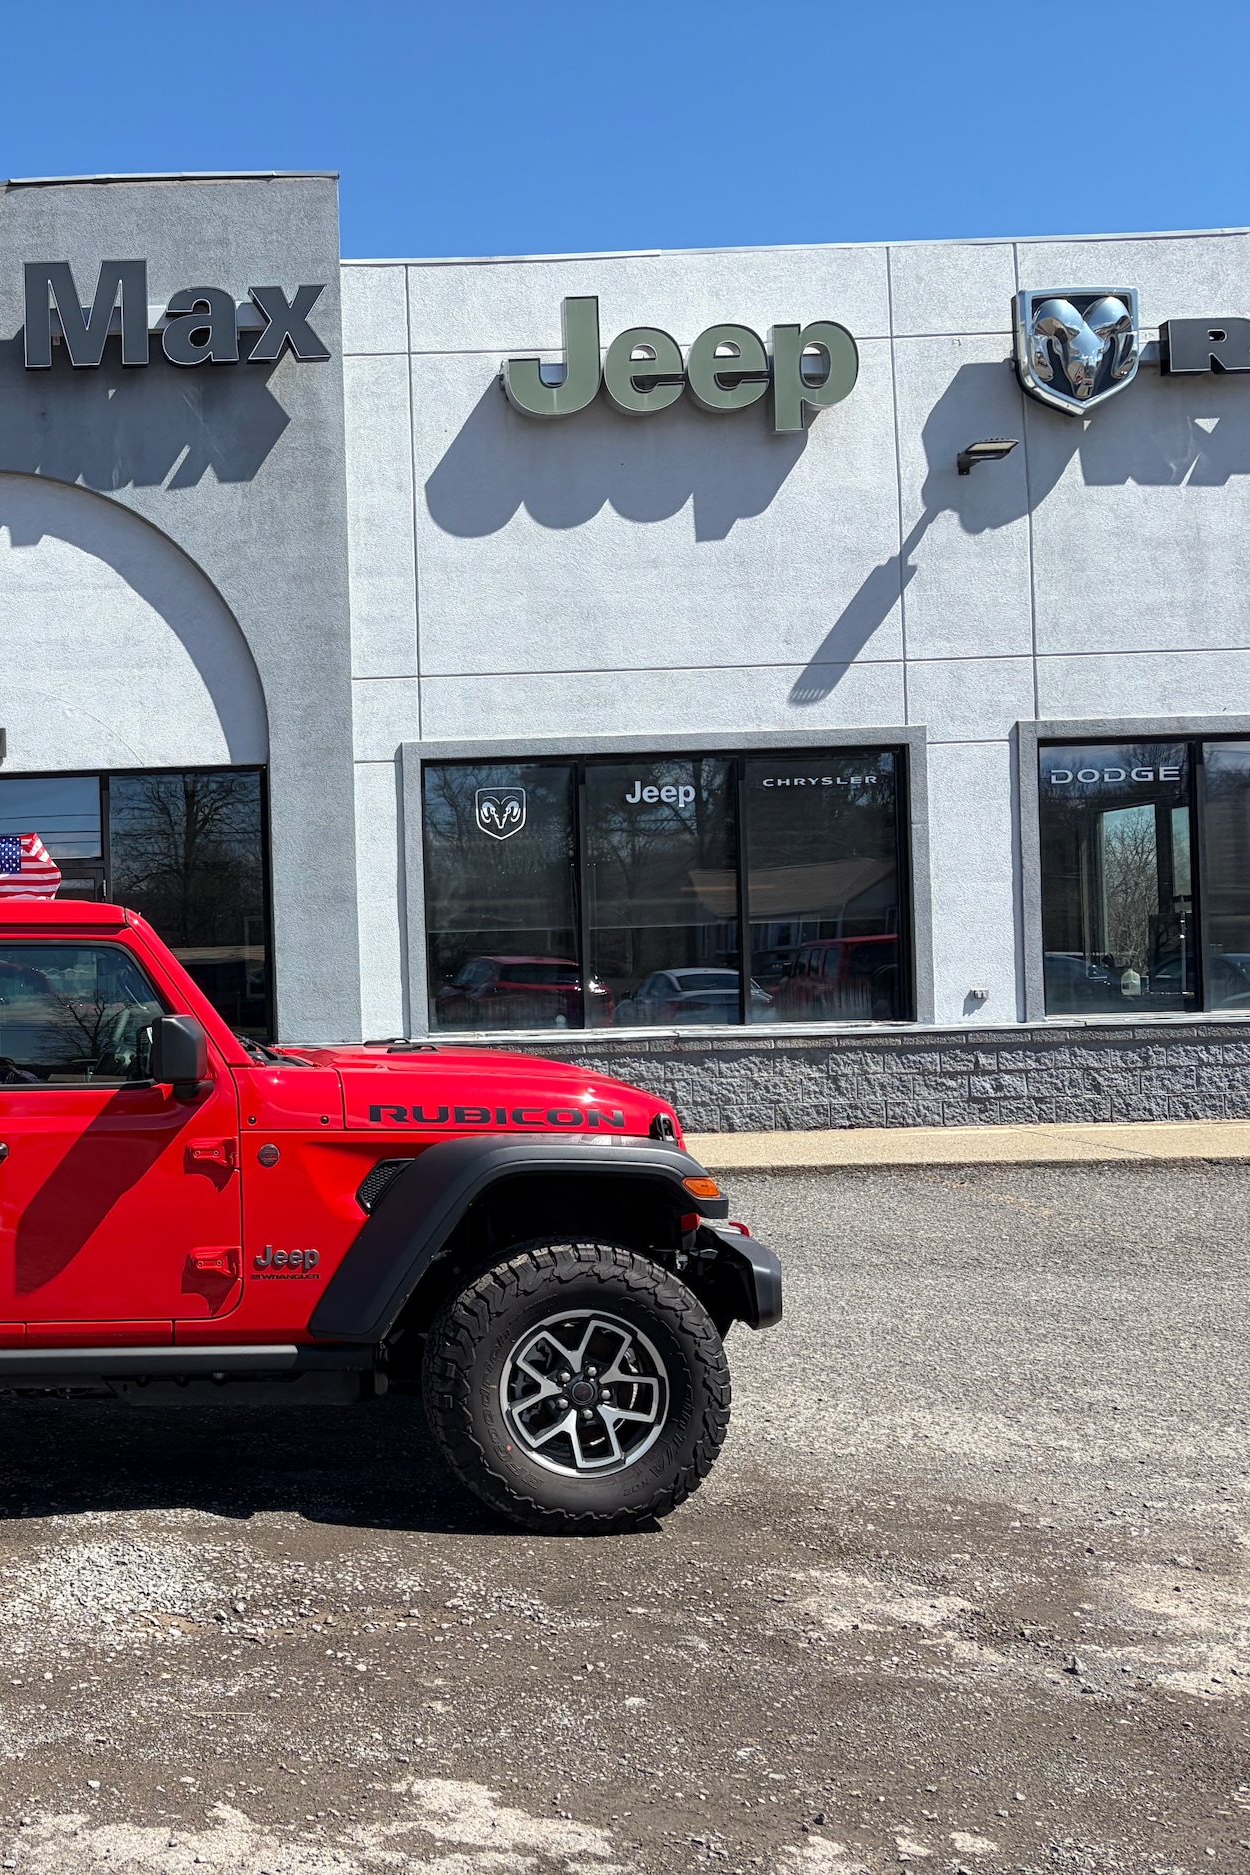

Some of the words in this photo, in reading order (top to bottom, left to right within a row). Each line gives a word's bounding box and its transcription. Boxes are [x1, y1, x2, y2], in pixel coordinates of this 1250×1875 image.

[23, 259, 331, 369] Max
[501, 295, 860, 434] Jeep
[762, 775, 878, 787] CHRYSLER
[1050, 766, 1181, 784] DODGE
[625, 780, 696, 807] Jeep
[369, 1104, 626, 1127] RUBICON
[254, 1244, 320, 1270] Jeep
